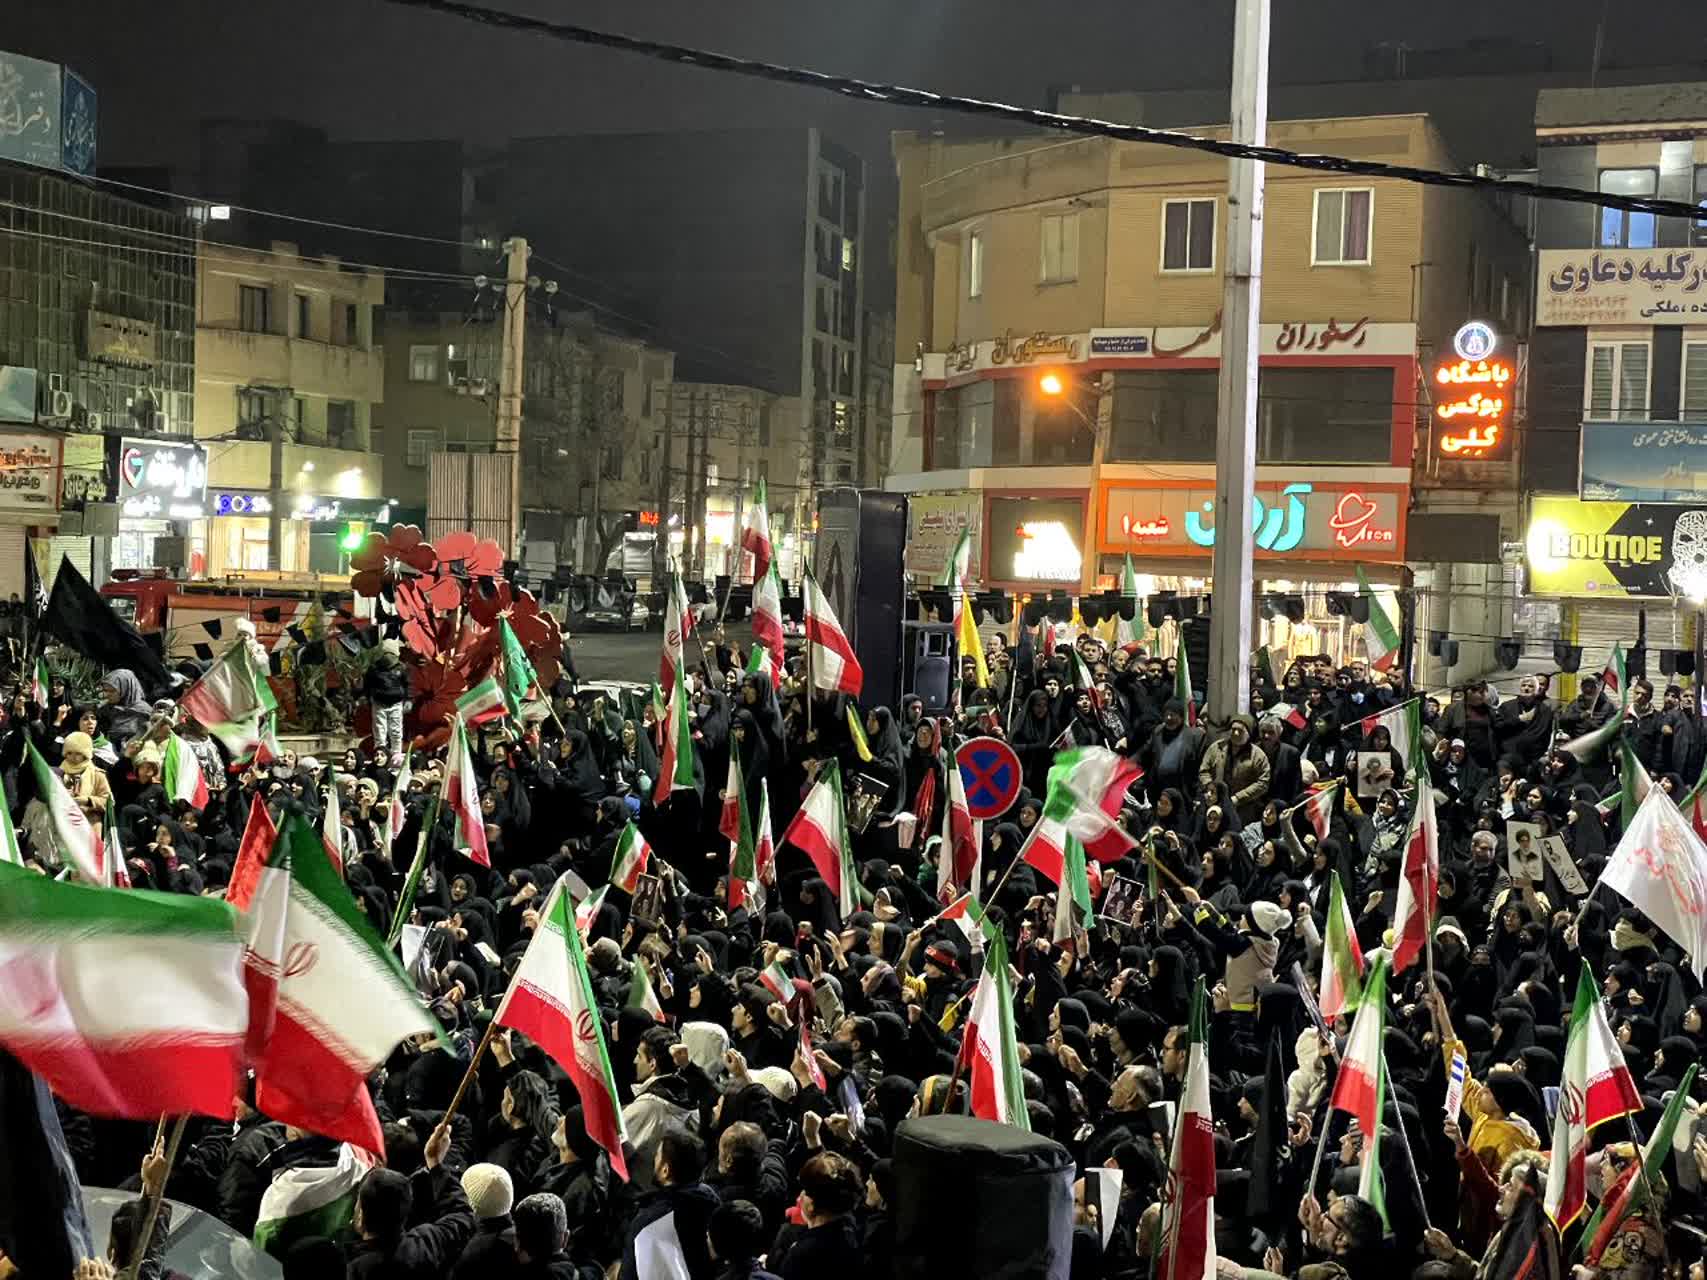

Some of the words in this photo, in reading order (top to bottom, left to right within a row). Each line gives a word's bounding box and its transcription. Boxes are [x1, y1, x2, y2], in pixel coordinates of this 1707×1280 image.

[1550, 254, 1634, 293] دعاوی
[1638, 253, 1692, 289] کلیه
[1276, 315, 1369, 351] رستوران
[1436, 360, 1510, 388] باشگاه
[1437, 392, 1503, 418] بوکس
[1551, 533, 1662, 563] BOUTIQE
